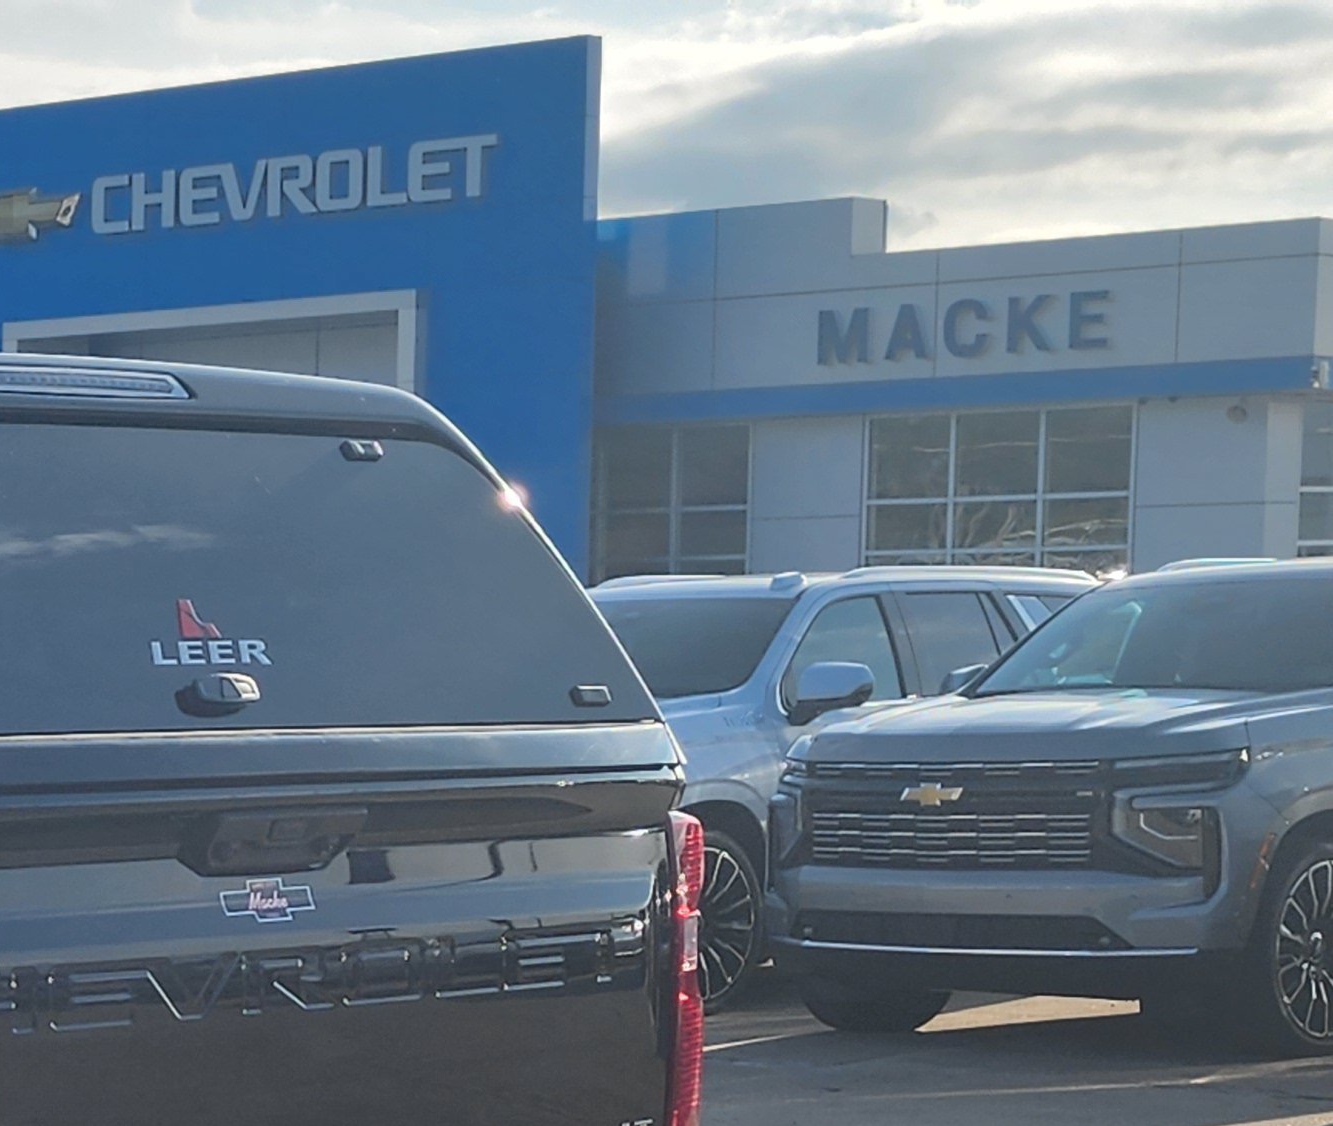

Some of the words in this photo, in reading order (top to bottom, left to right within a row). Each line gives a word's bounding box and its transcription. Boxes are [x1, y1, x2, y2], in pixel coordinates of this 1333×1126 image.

[90, 133, 498, 237] CHEVROLET
[817, 289, 1111, 366] MACKE
[150, 639, 273, 666] LEER
